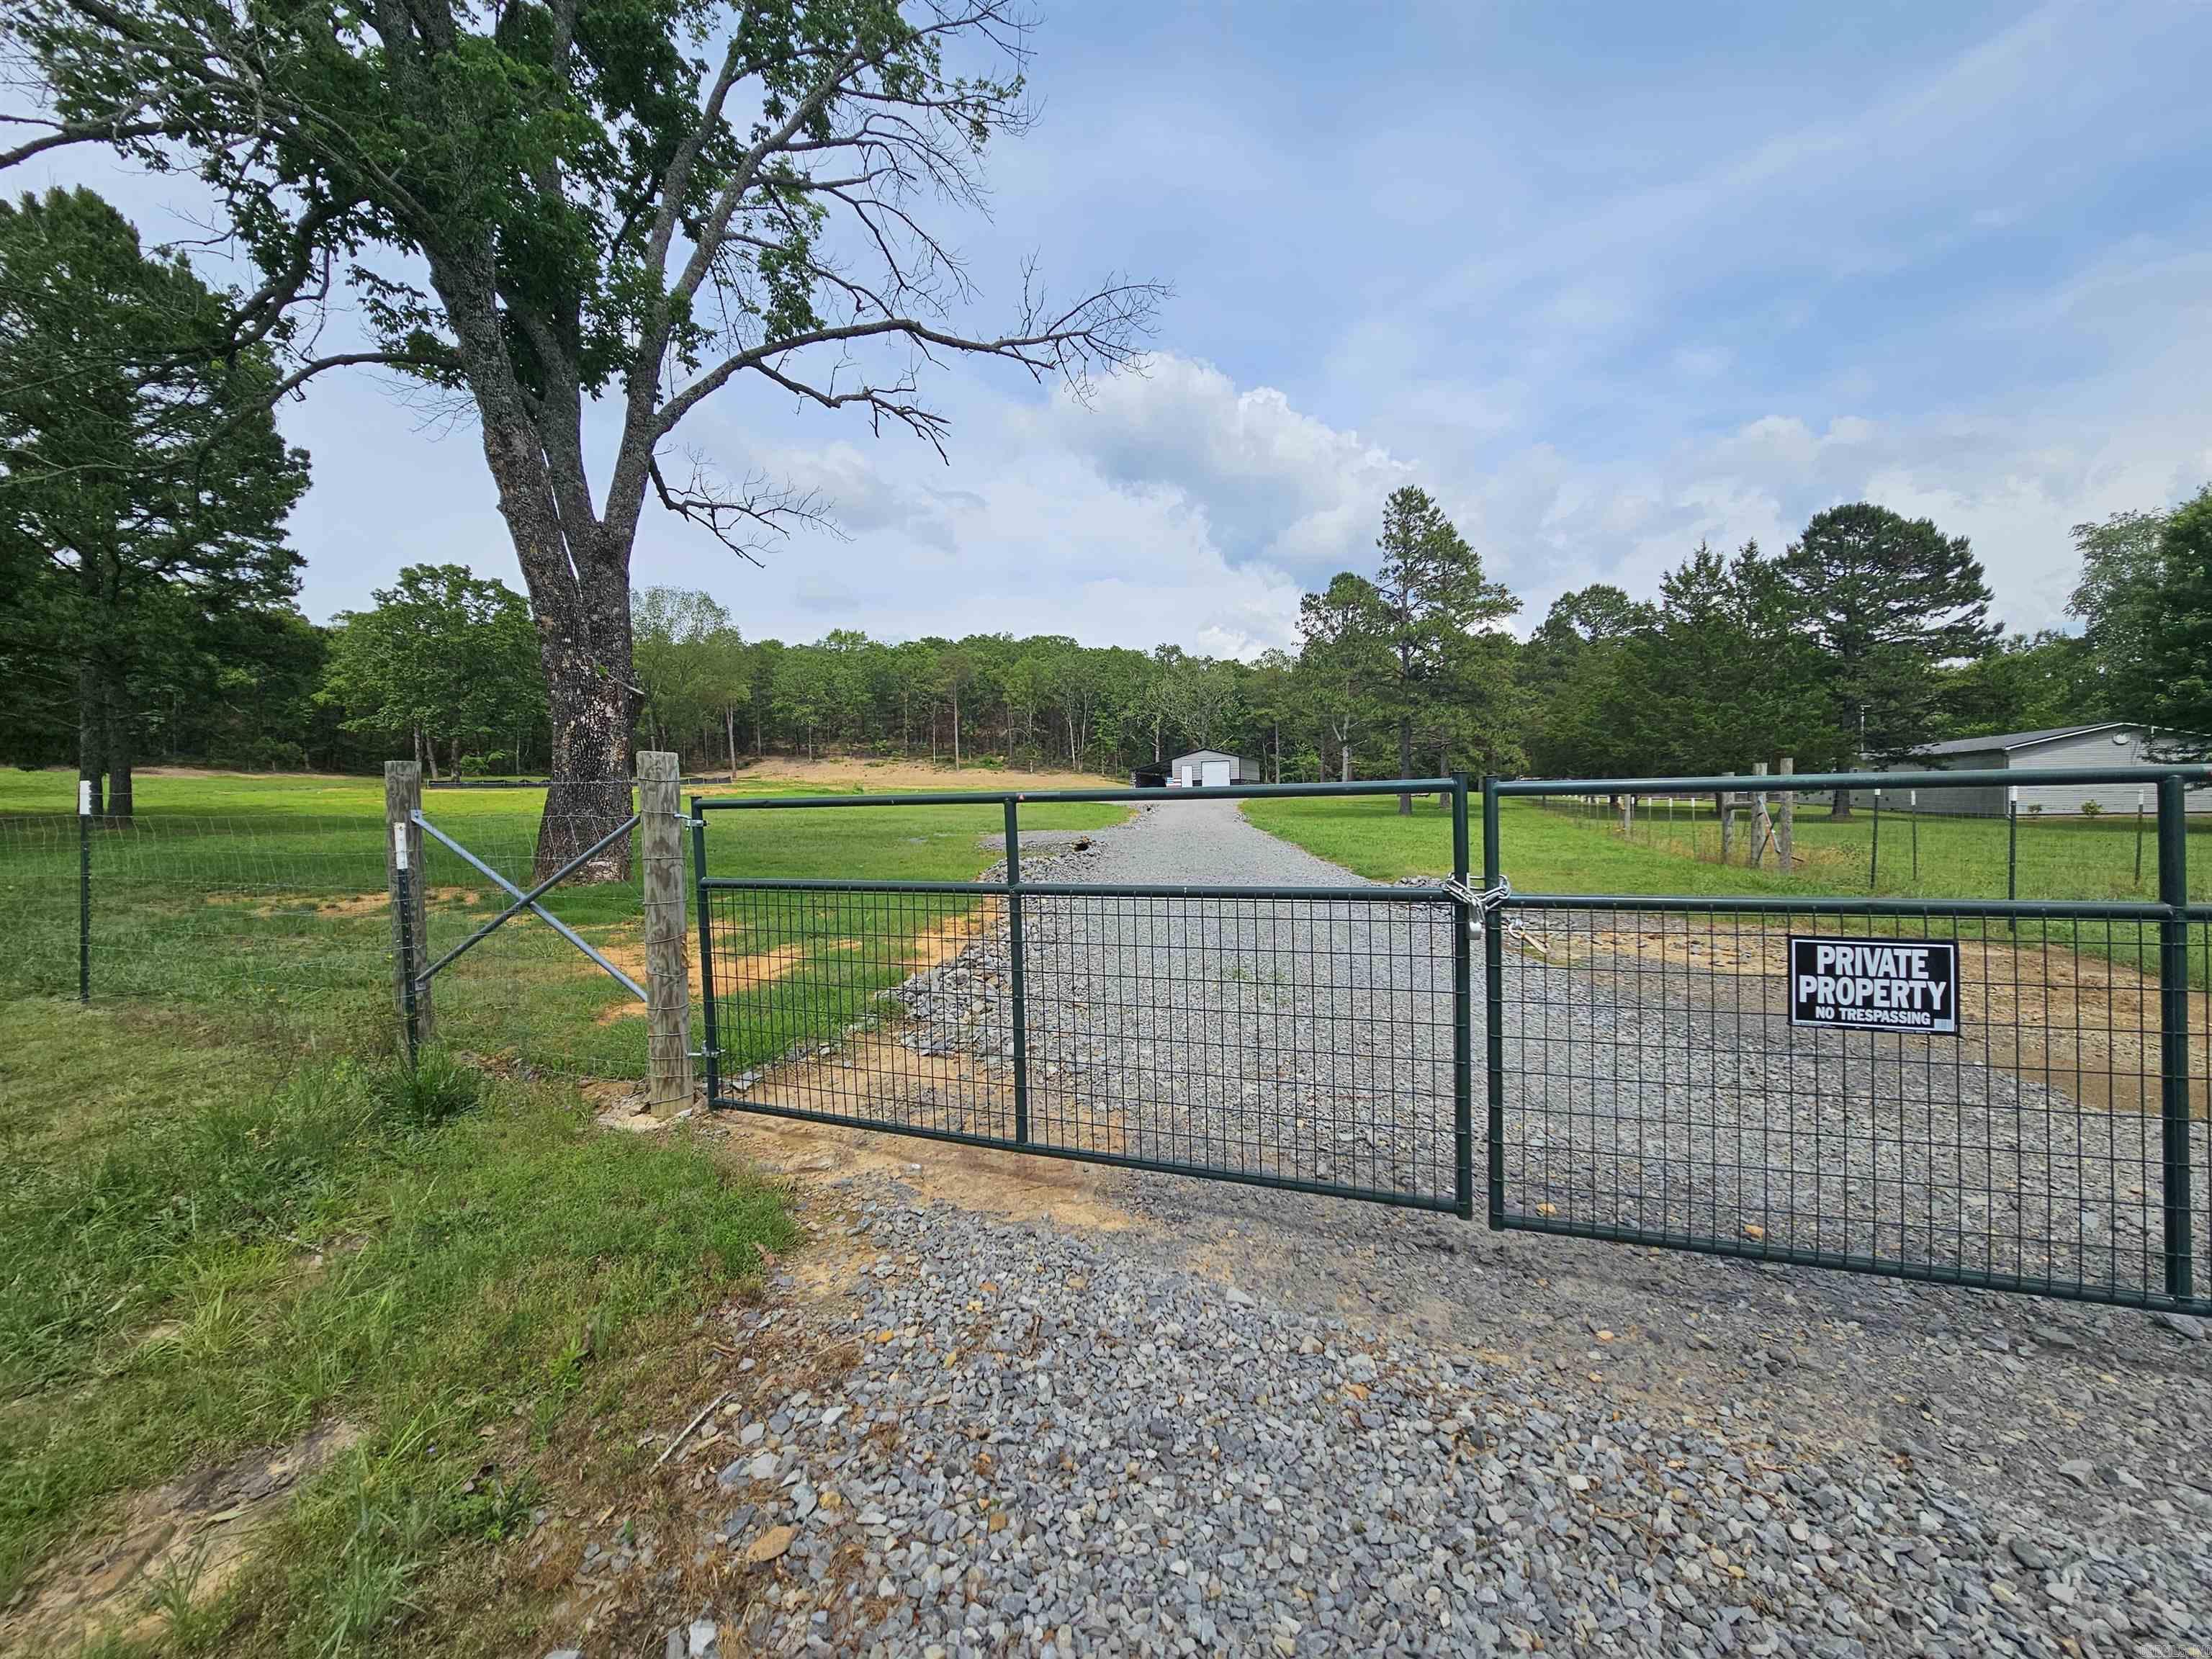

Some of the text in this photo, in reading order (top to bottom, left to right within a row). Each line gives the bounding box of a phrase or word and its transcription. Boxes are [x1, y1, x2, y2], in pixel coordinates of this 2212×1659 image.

[1817, 945, 1929, 979] PRIVATE
[1799, 975, 1946, 1010] PROPERTY
[1815, 1007, 1835, 1020] NO
[1839, 1007, 1930, 1025] TRESPASSING
